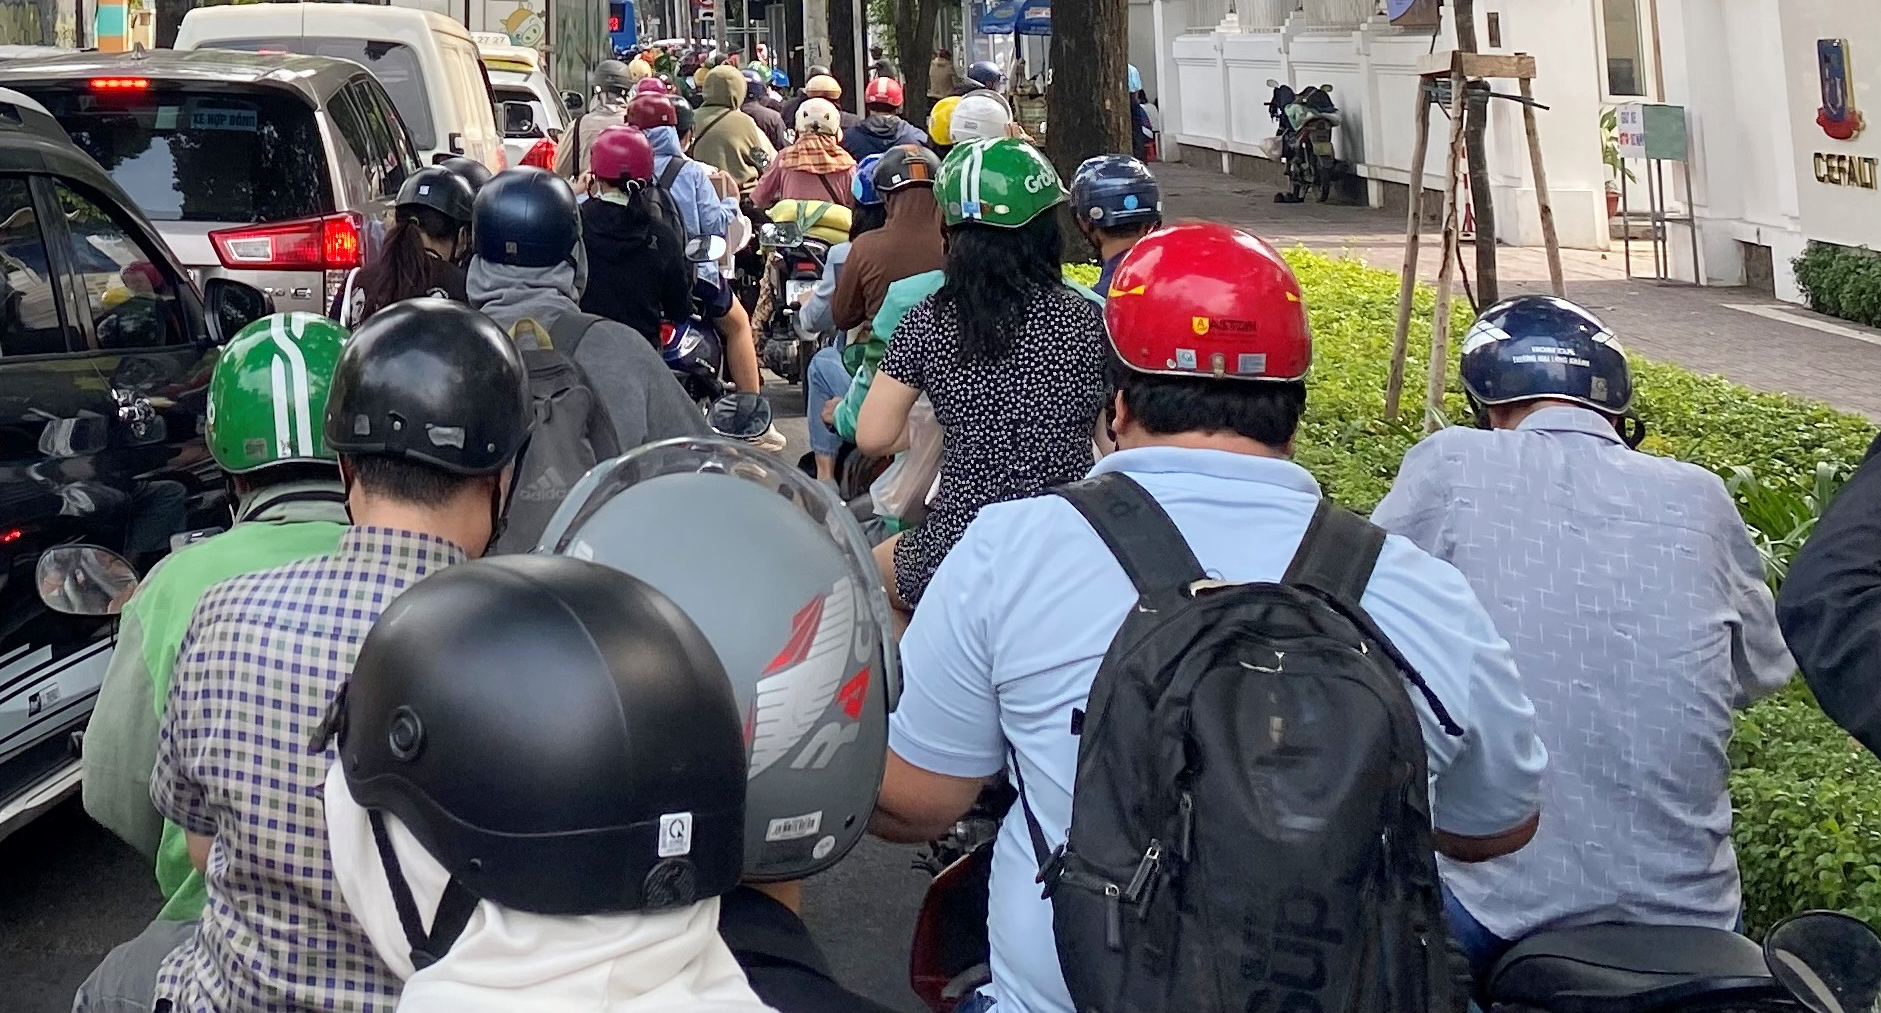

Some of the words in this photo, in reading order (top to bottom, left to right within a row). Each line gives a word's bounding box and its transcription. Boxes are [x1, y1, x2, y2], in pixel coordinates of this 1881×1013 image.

[1814, 152, 1878, 191] CEFALT
[1531, 346, 1576, 356] HONDA
[520, 485, 567, 501] adida
